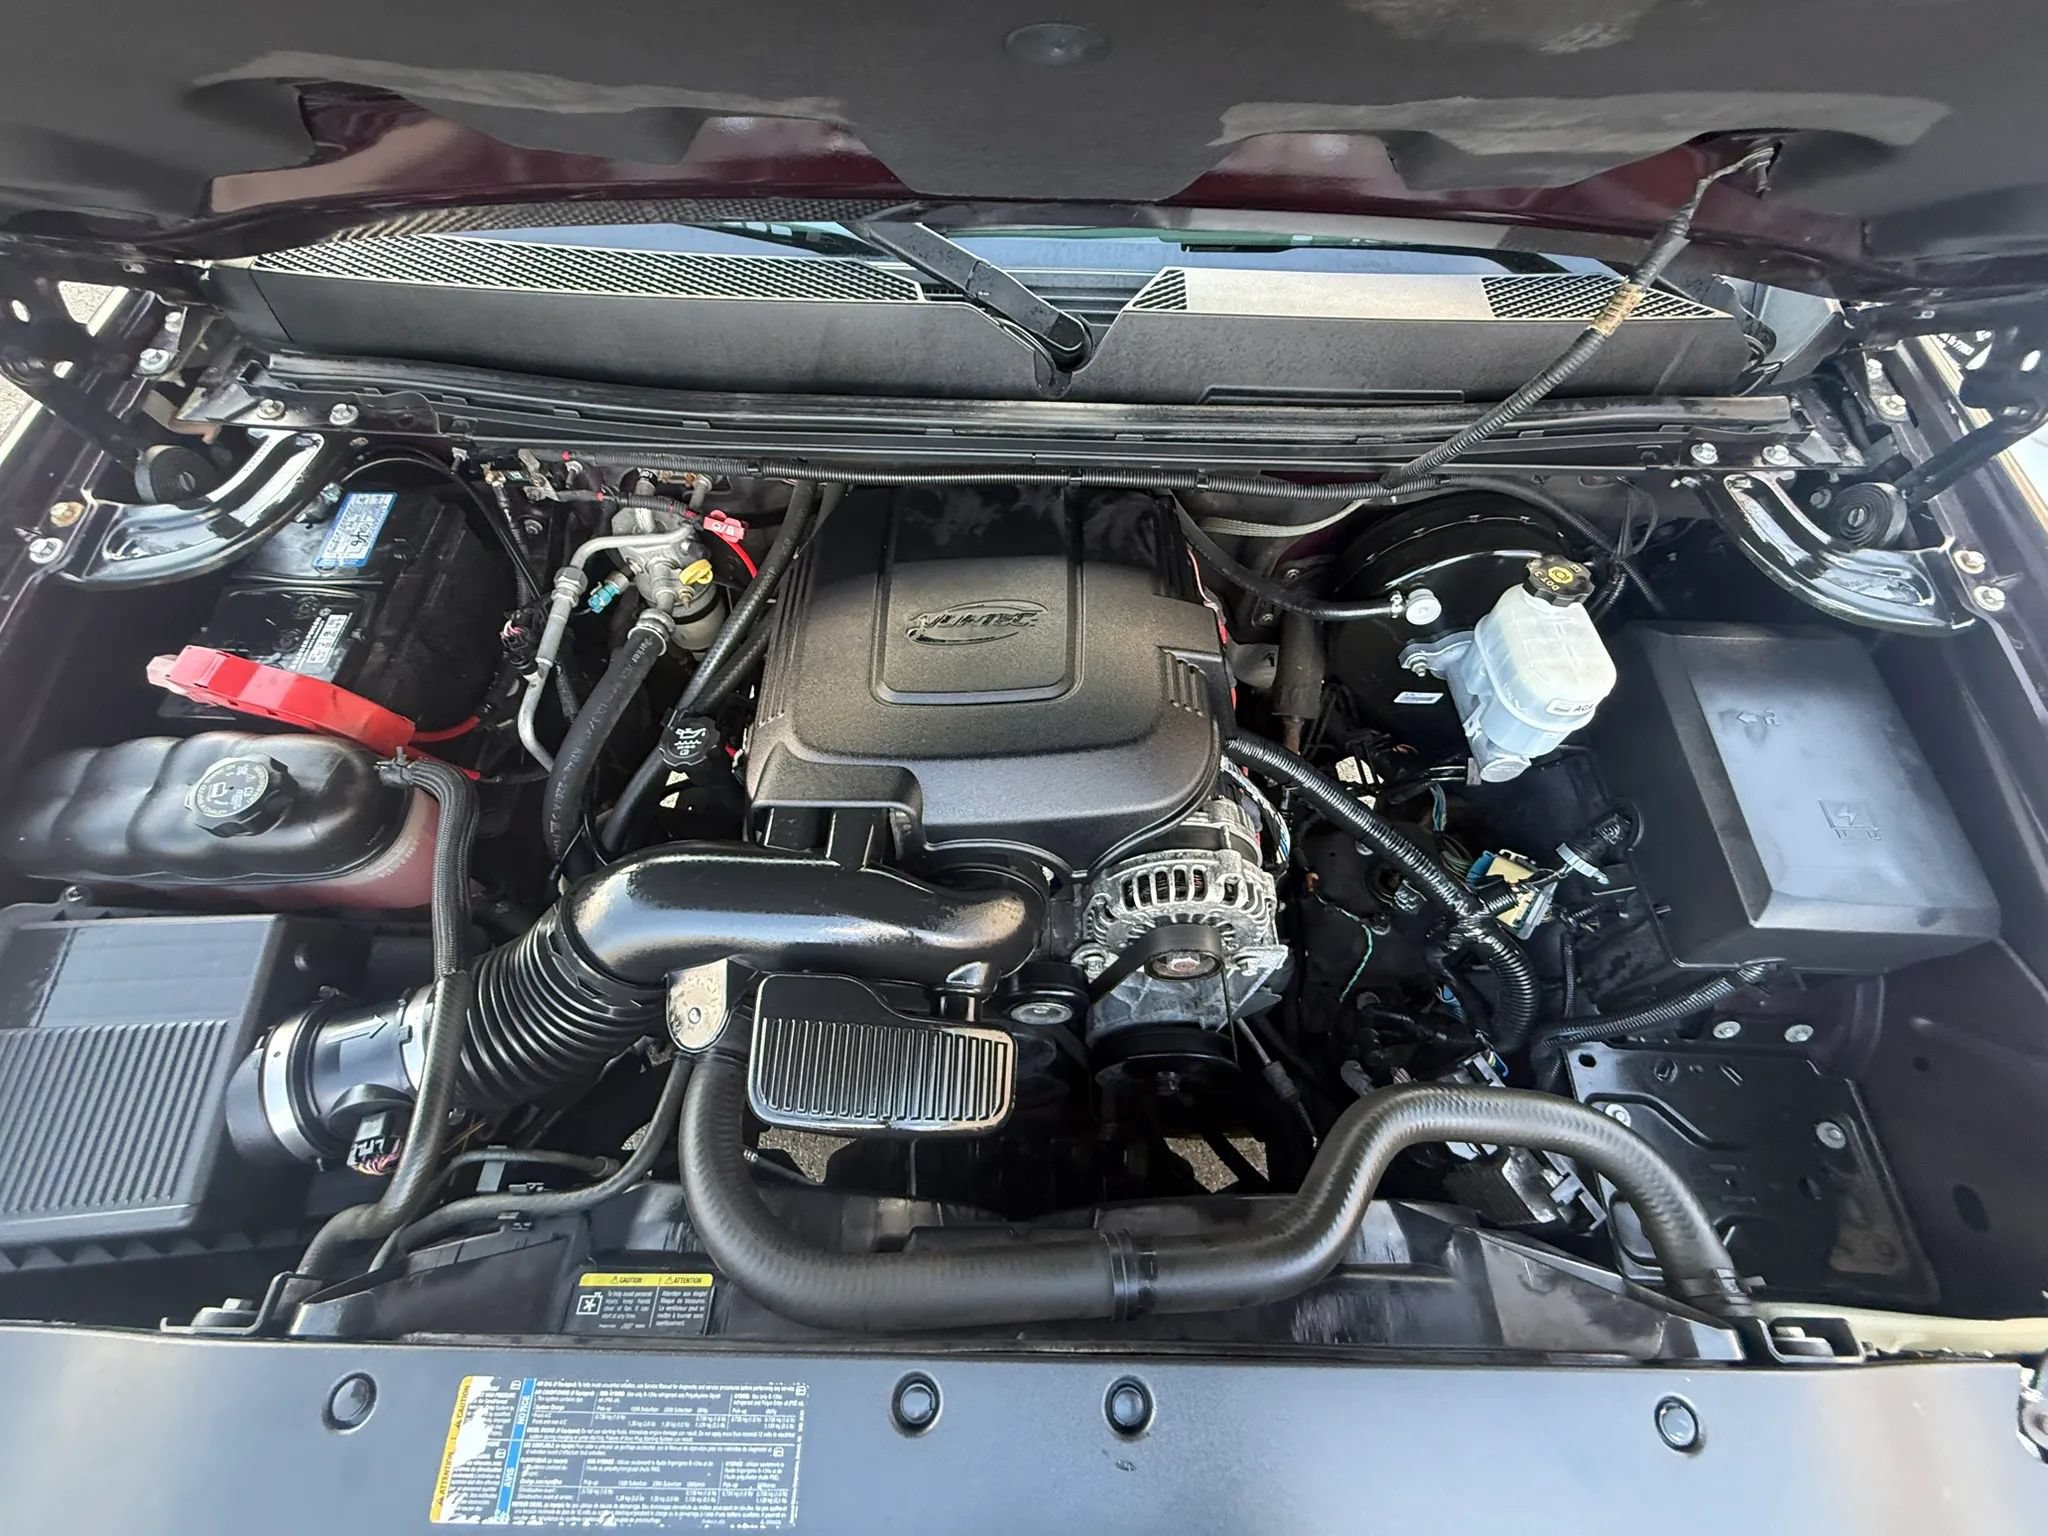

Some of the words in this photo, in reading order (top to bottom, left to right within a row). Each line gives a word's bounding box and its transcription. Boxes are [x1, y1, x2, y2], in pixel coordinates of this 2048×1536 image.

[1540, 577, 1560, 591] DOT
[458, 1385, 470, 1418] CAUTION
[517, 1396, 530, 1425] NOTICE
[440, 1451, 454, 1493] ATTENTION
[503, 1467, 515, 1487] AVIS
